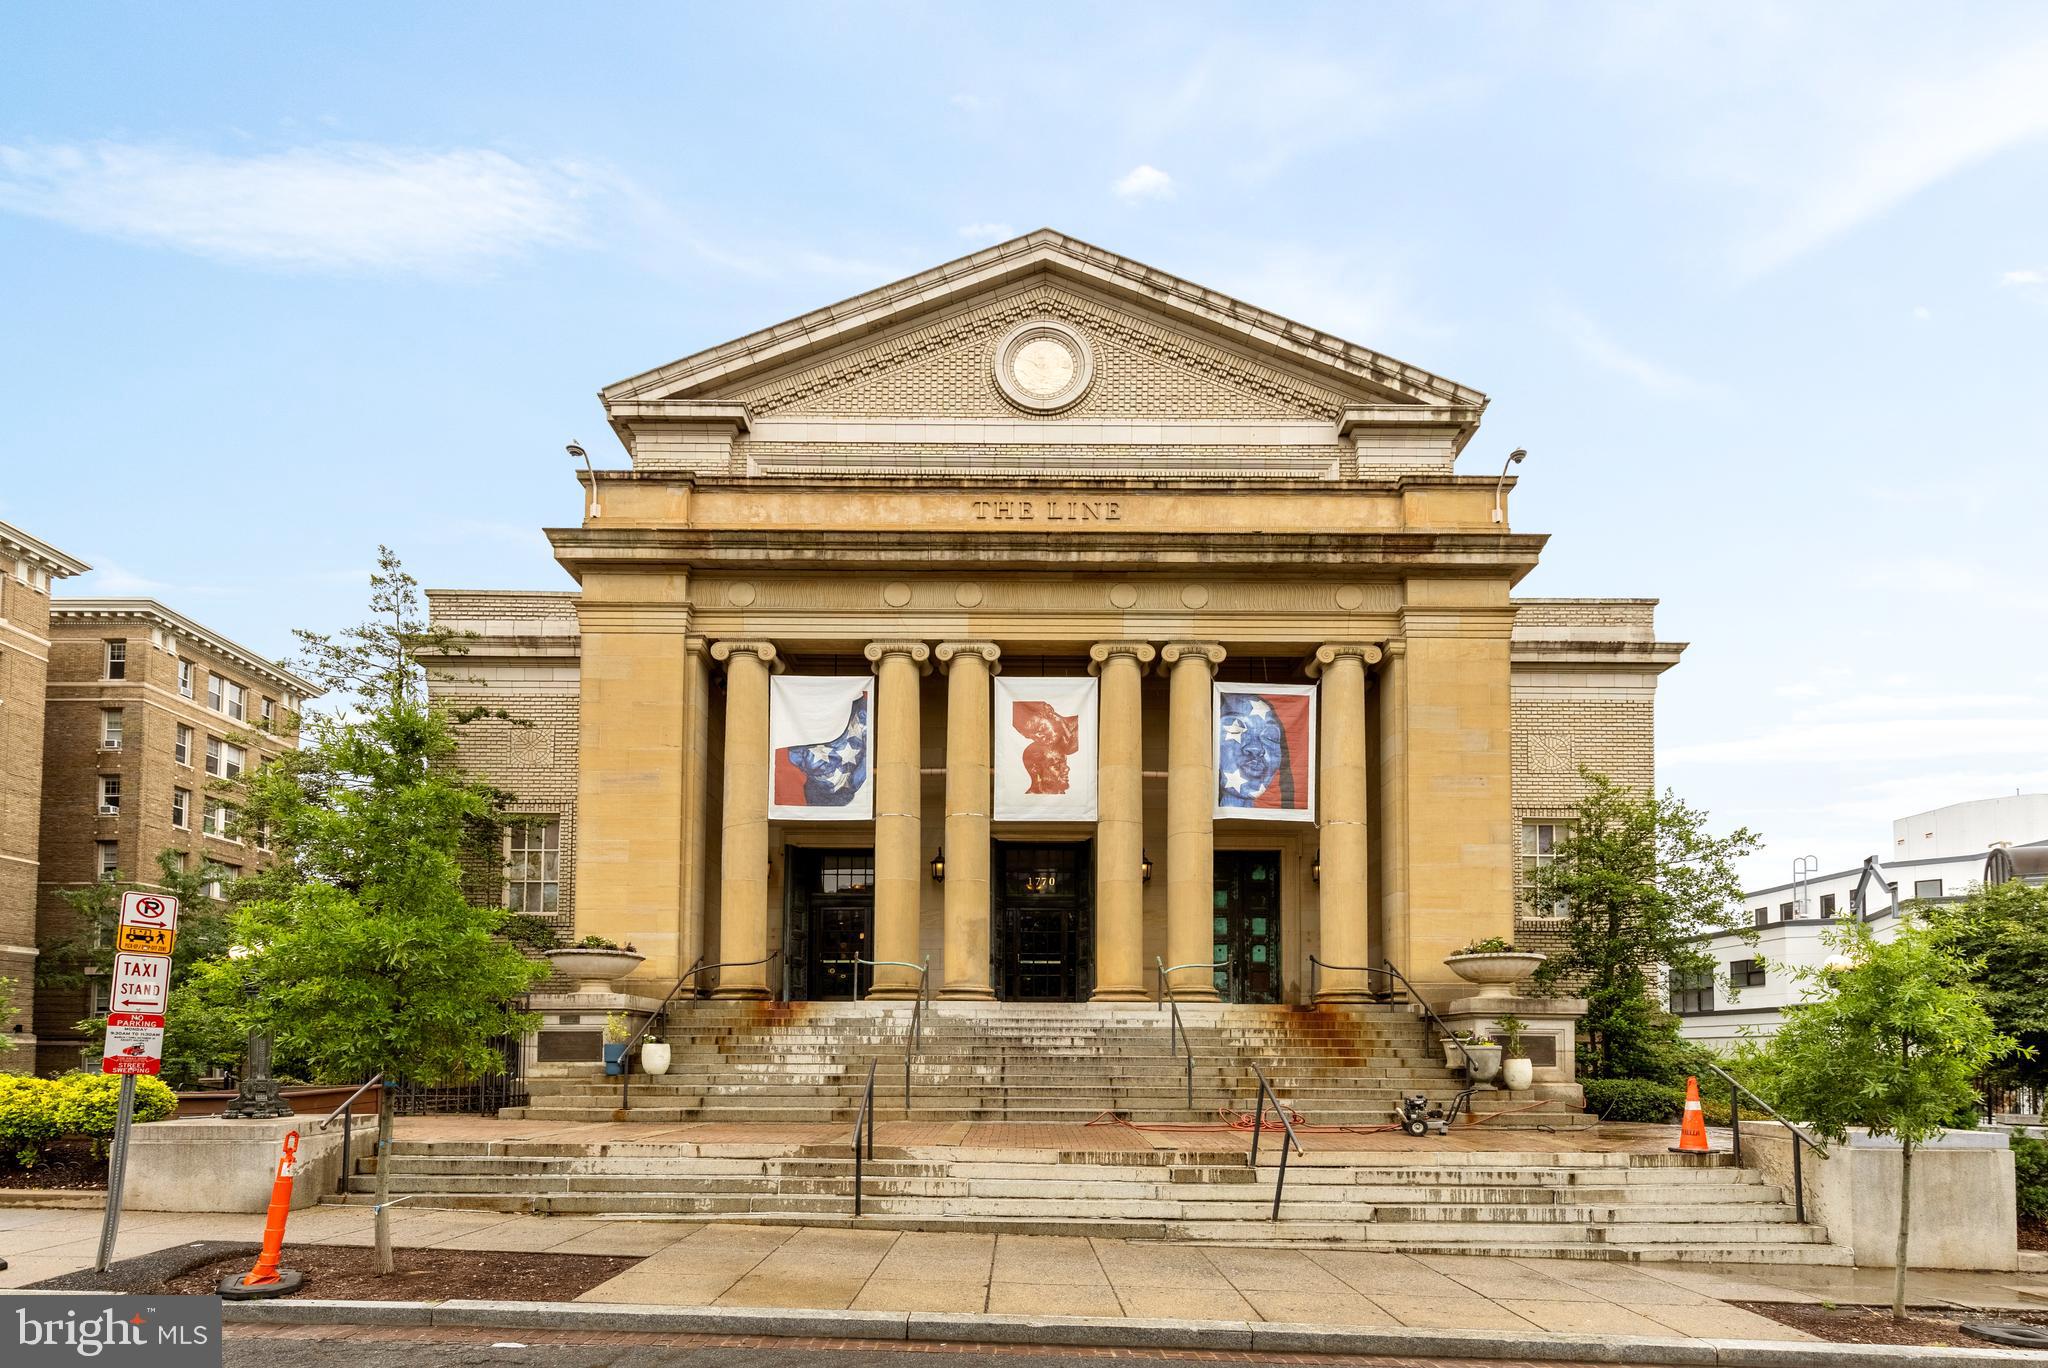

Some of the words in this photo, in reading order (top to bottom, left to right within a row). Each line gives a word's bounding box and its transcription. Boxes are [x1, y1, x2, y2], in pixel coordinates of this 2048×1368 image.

[973, 501, 1034, 520] THE
[1047, 501, 1121, 521] LINE
[1028, 877, 1055, 886] 1770
[124, 962, 157, 977] TAXI
[121, 982, 160, 996] STAND
